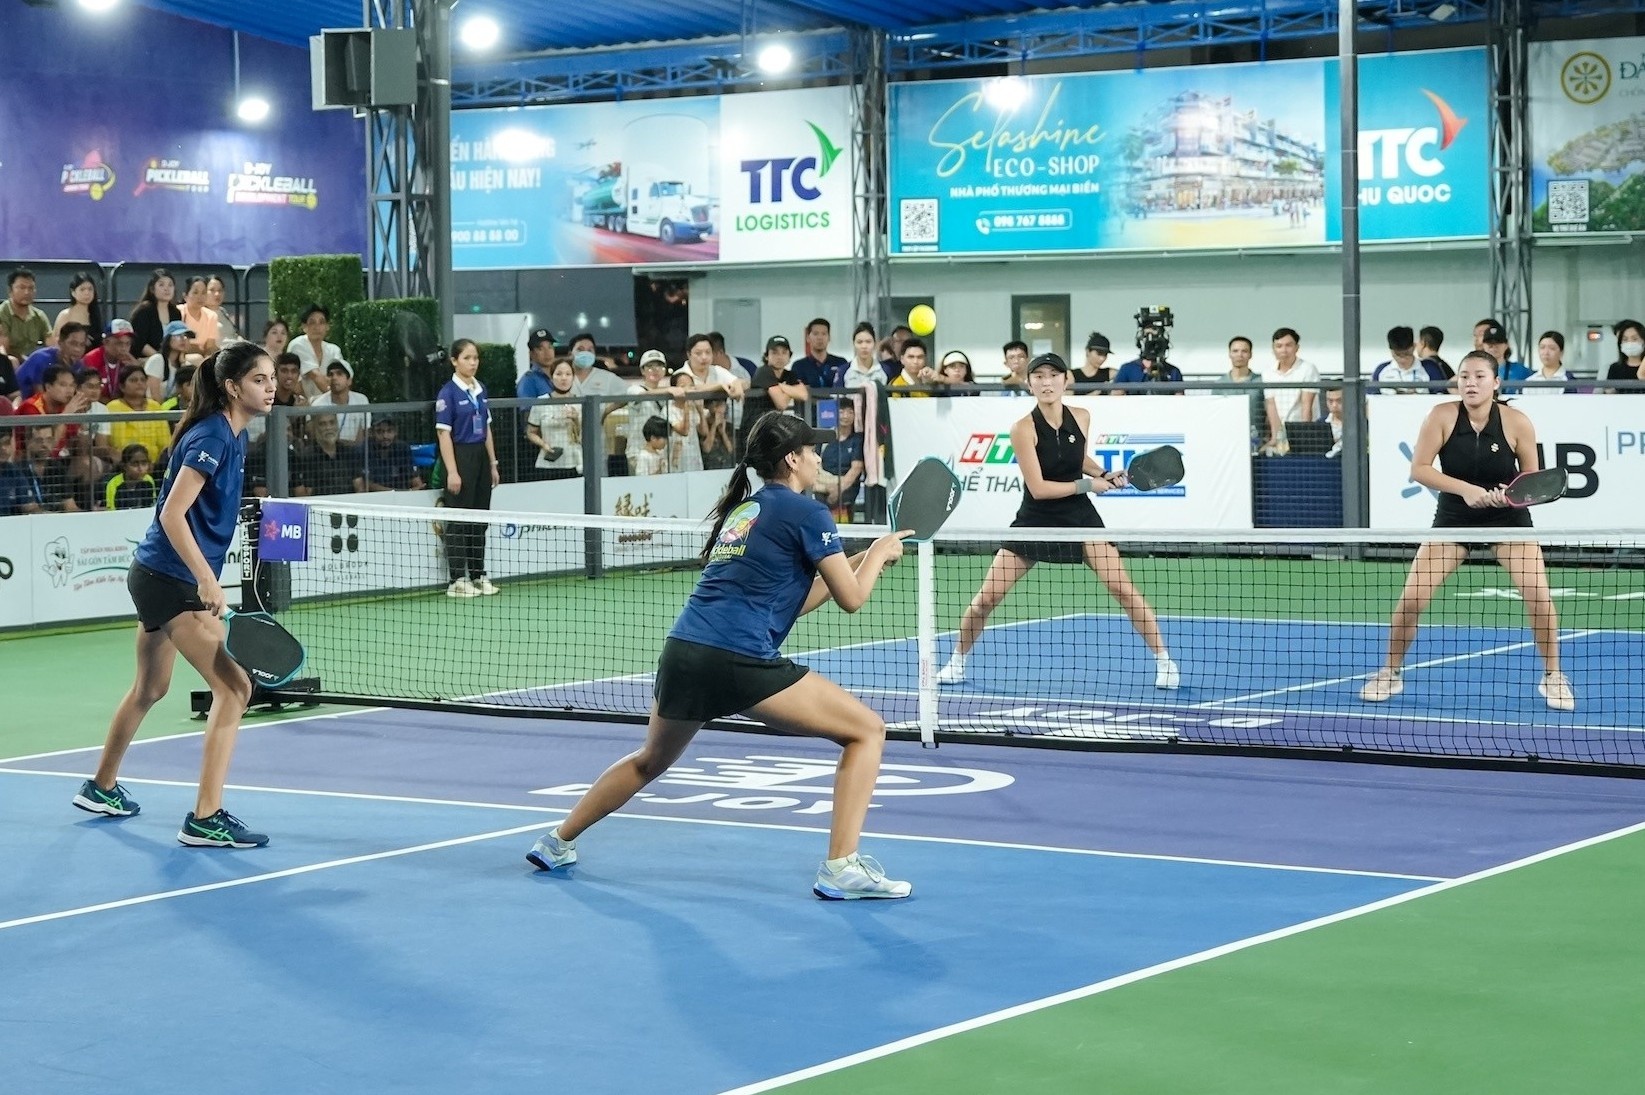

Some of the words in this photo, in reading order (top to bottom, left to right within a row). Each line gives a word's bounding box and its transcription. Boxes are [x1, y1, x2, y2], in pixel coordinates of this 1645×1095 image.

[1357, 127, 1445, 180] TTC
[146, 168, 210, 185] PICKLEBALL
[469, 165, 504, 195] HIỆN
[507, 167, 541, 189] NAY!
[740, 157, 822, 203] TTC
[227, 173, 317, 204] PICKLEBALL
[950, 184, 974, 198] NHÀ
[974, 182, 1000, 197] PHỐ
[1001, 183, 1048, 197] THƯƠNG
[1049, 183, 1071, 197] MẠI
[1387, 183, 1452, 205] QUOC
[736, 211, 830, 231] LOGISTICS
[1016, 214, 1037, 227] 767
[959, 434, 1019, 464] HT
[986, 476, 1022, 492] THA
[281, 524, 302, 539] MB
